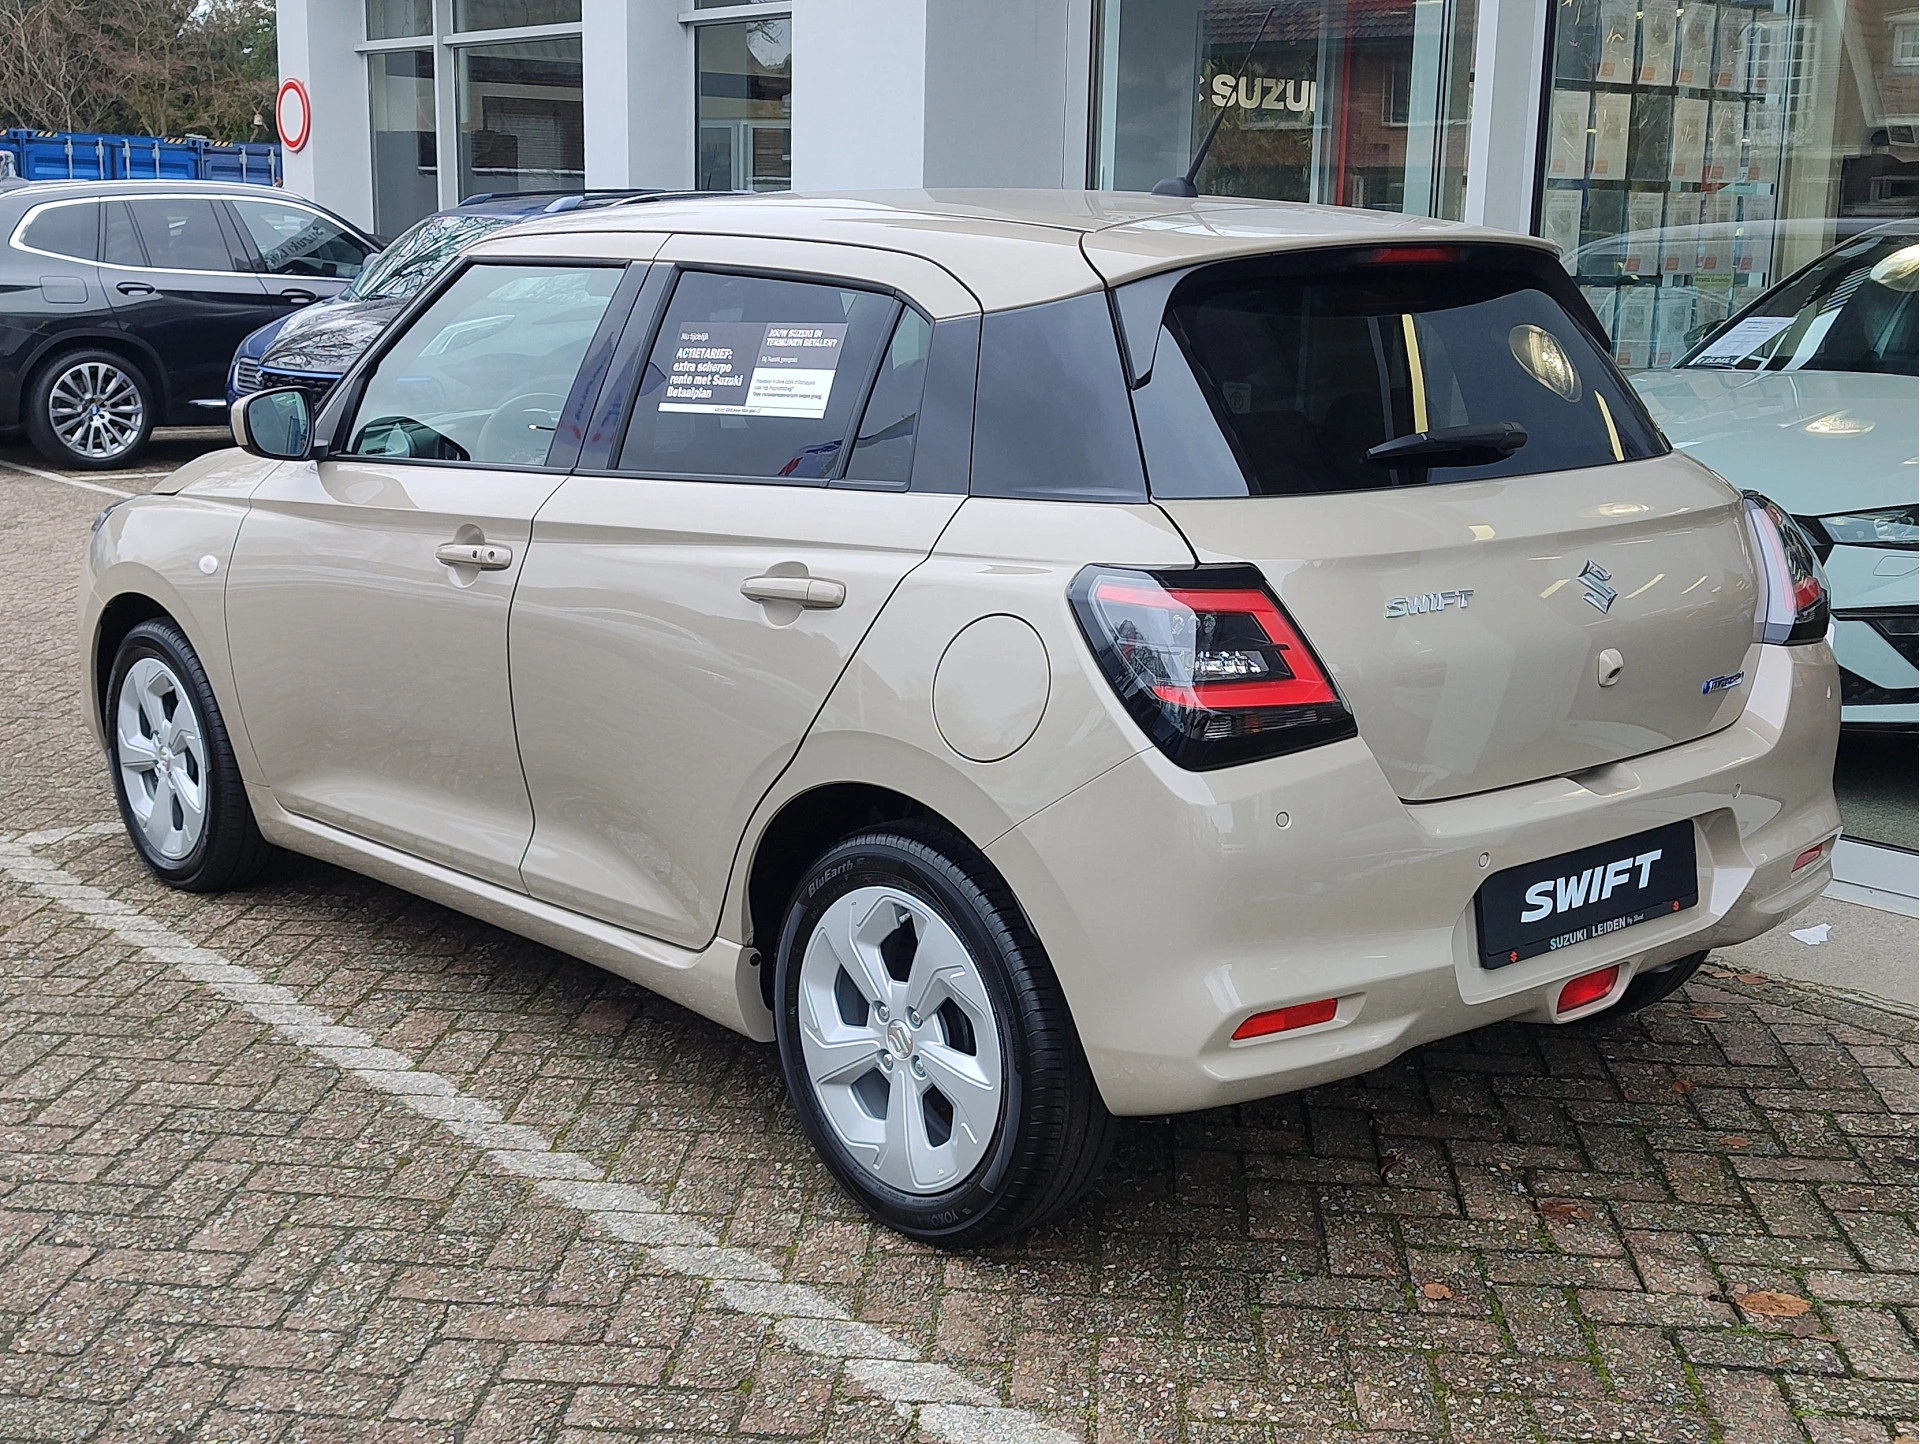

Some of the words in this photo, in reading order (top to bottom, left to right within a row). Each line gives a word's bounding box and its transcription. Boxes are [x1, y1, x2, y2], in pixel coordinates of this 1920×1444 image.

[676, 347, 734, 360] ACTIETARIEF:
[673, 361, 697, 372] extra
[697, 361, 732, 374] scherpe
[669, 374, 693, 385] rente
[693, 375, 711, 385] met
[712, 375, 744, 386] Suzuki
[666, 386, 713, 400] Betaalplan
[1385, 589, 1474, 619] SWIFT
[1520, 849, 1663, 923] SWIFT
[1550, 928, 1587, 950] SUZUKI
[1592, 916, 1626, 937] LEIDEN
